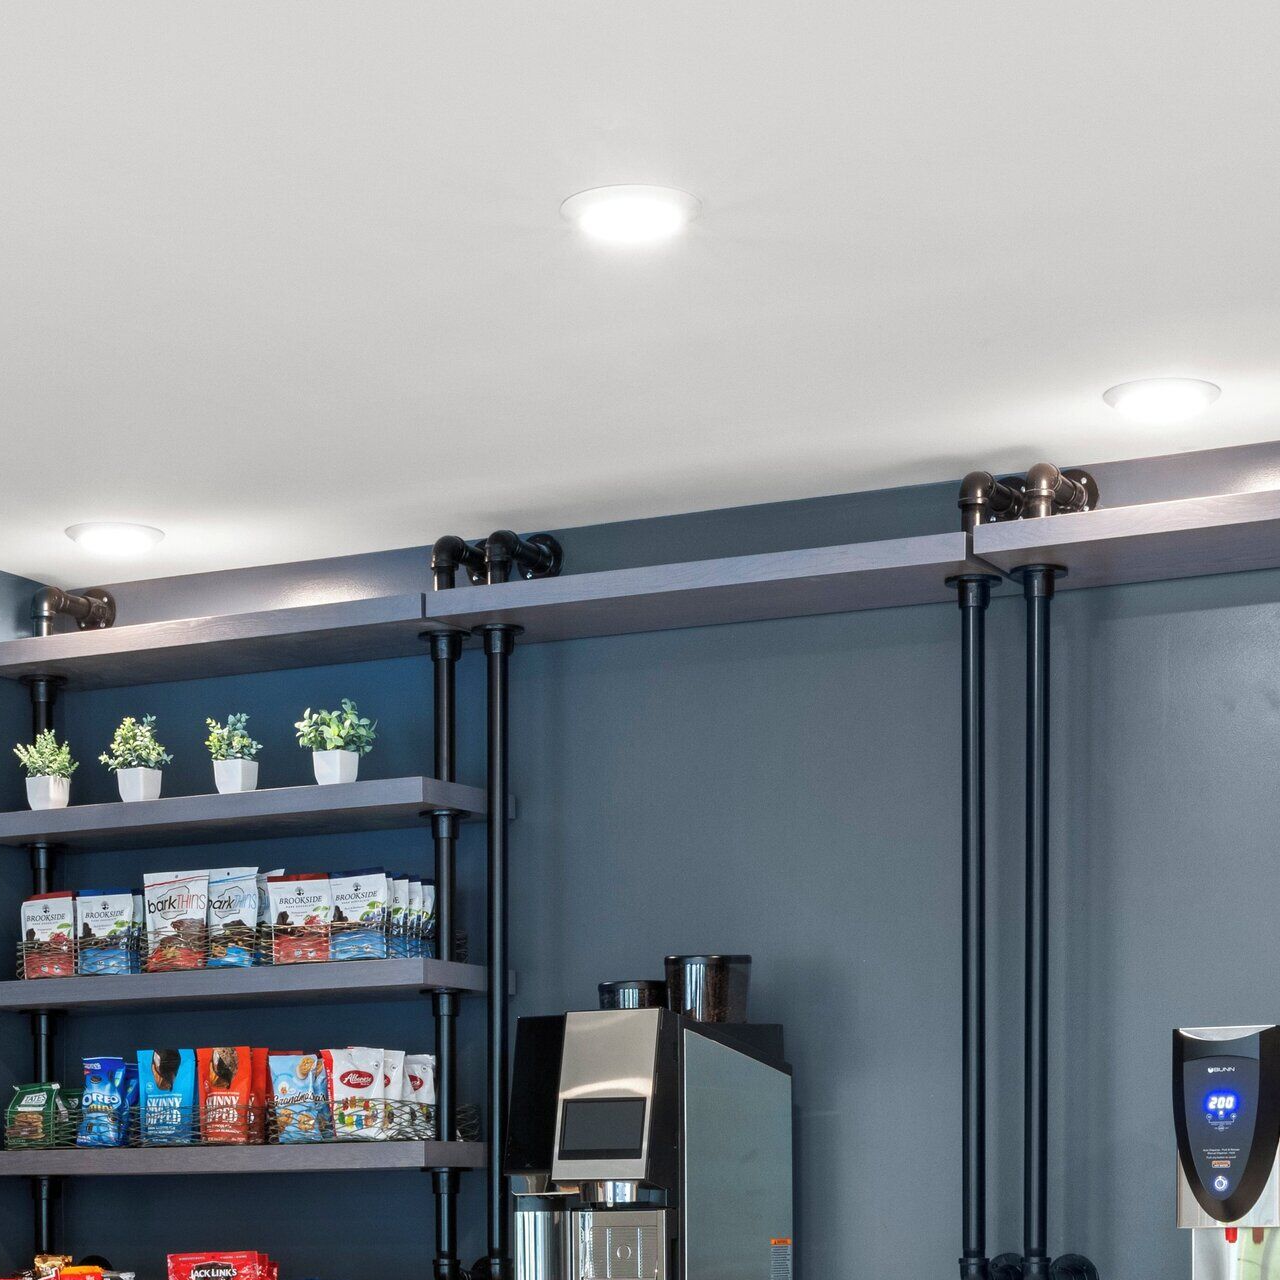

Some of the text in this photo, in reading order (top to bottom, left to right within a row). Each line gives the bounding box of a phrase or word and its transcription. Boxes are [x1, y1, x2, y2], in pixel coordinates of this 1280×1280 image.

[279, 895, 323, 905] BROOKSIDE
[335, 891, 378, 901] BROOKSIDE
[26, 912, 66, 922] BROOKSIDE
[84, 910, 124, 919] BROOKSIDE
[82, 1092, 120, 1106] OREO
[1207, 1095, 1235, 1110] 200
[190, 1269, 209, 1279] JACK
